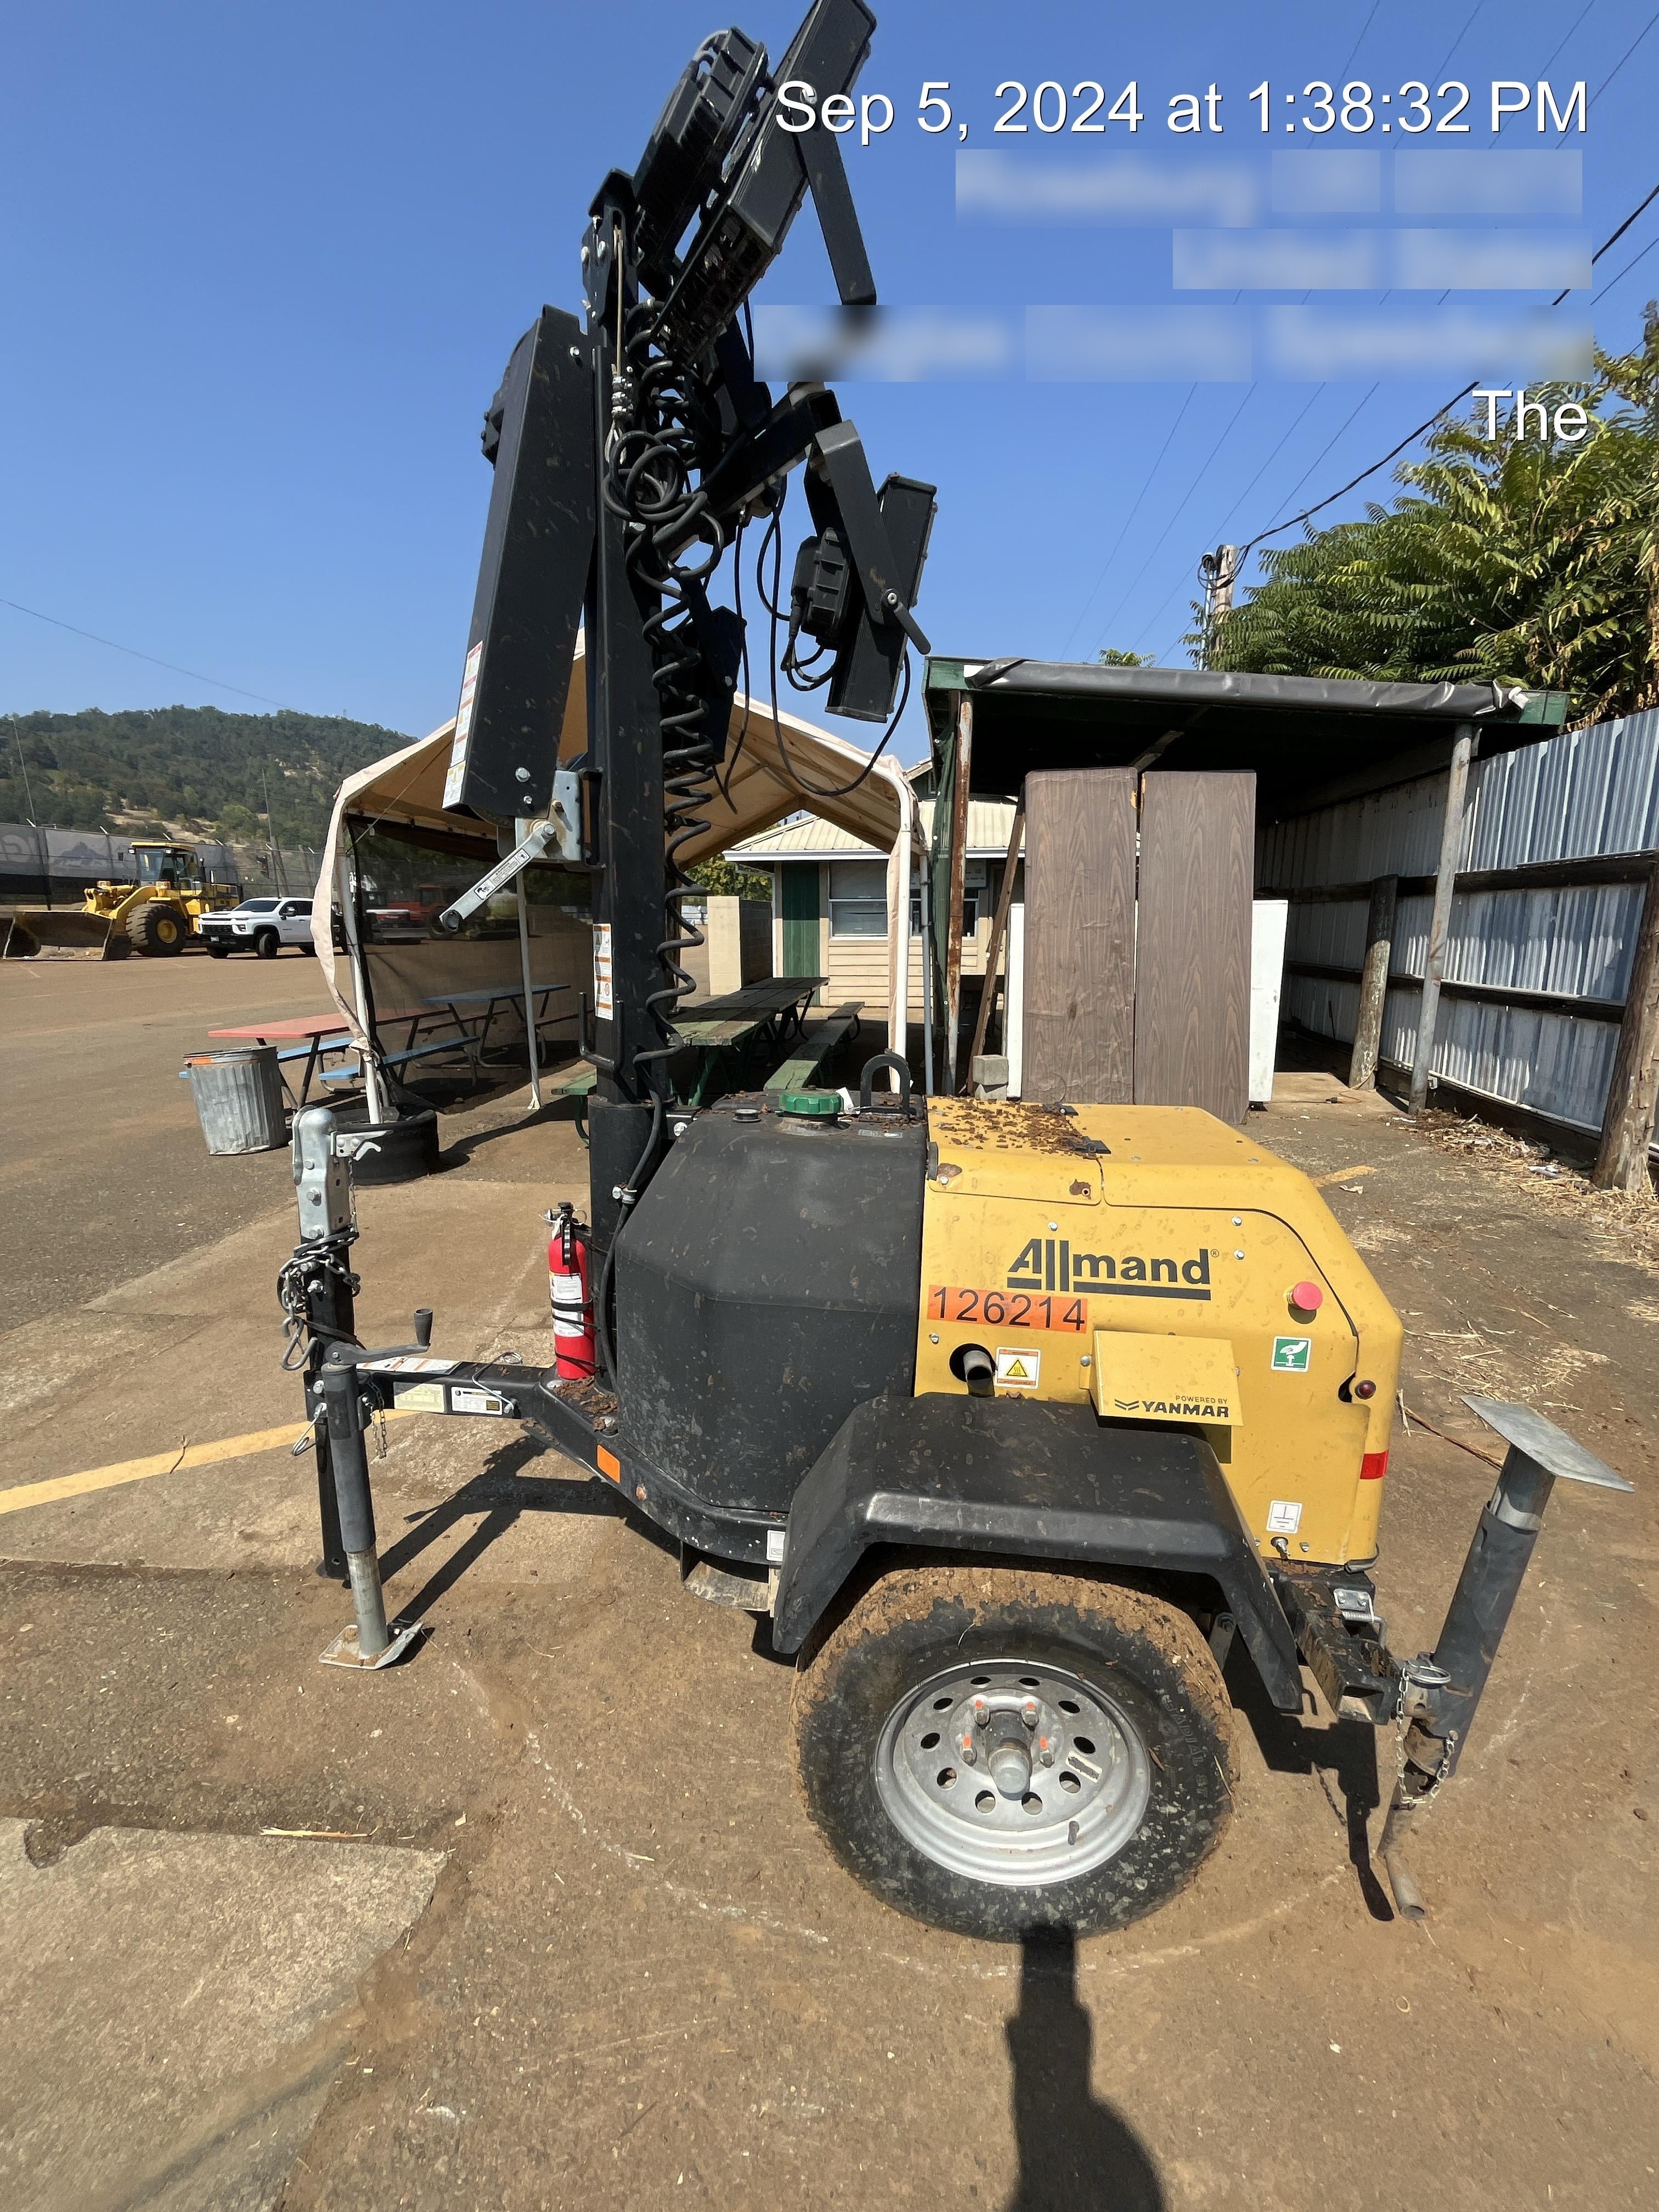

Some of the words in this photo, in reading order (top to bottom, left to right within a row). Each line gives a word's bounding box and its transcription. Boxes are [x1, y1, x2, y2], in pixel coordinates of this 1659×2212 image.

[1008, 1238, 1211, 1293] Allmand
[933, 1286, 1085, 1331] 126214
[1141, 1400, 1229, 1418] YANMAR
[1175, 1395, 1216, 1404] POWERED
